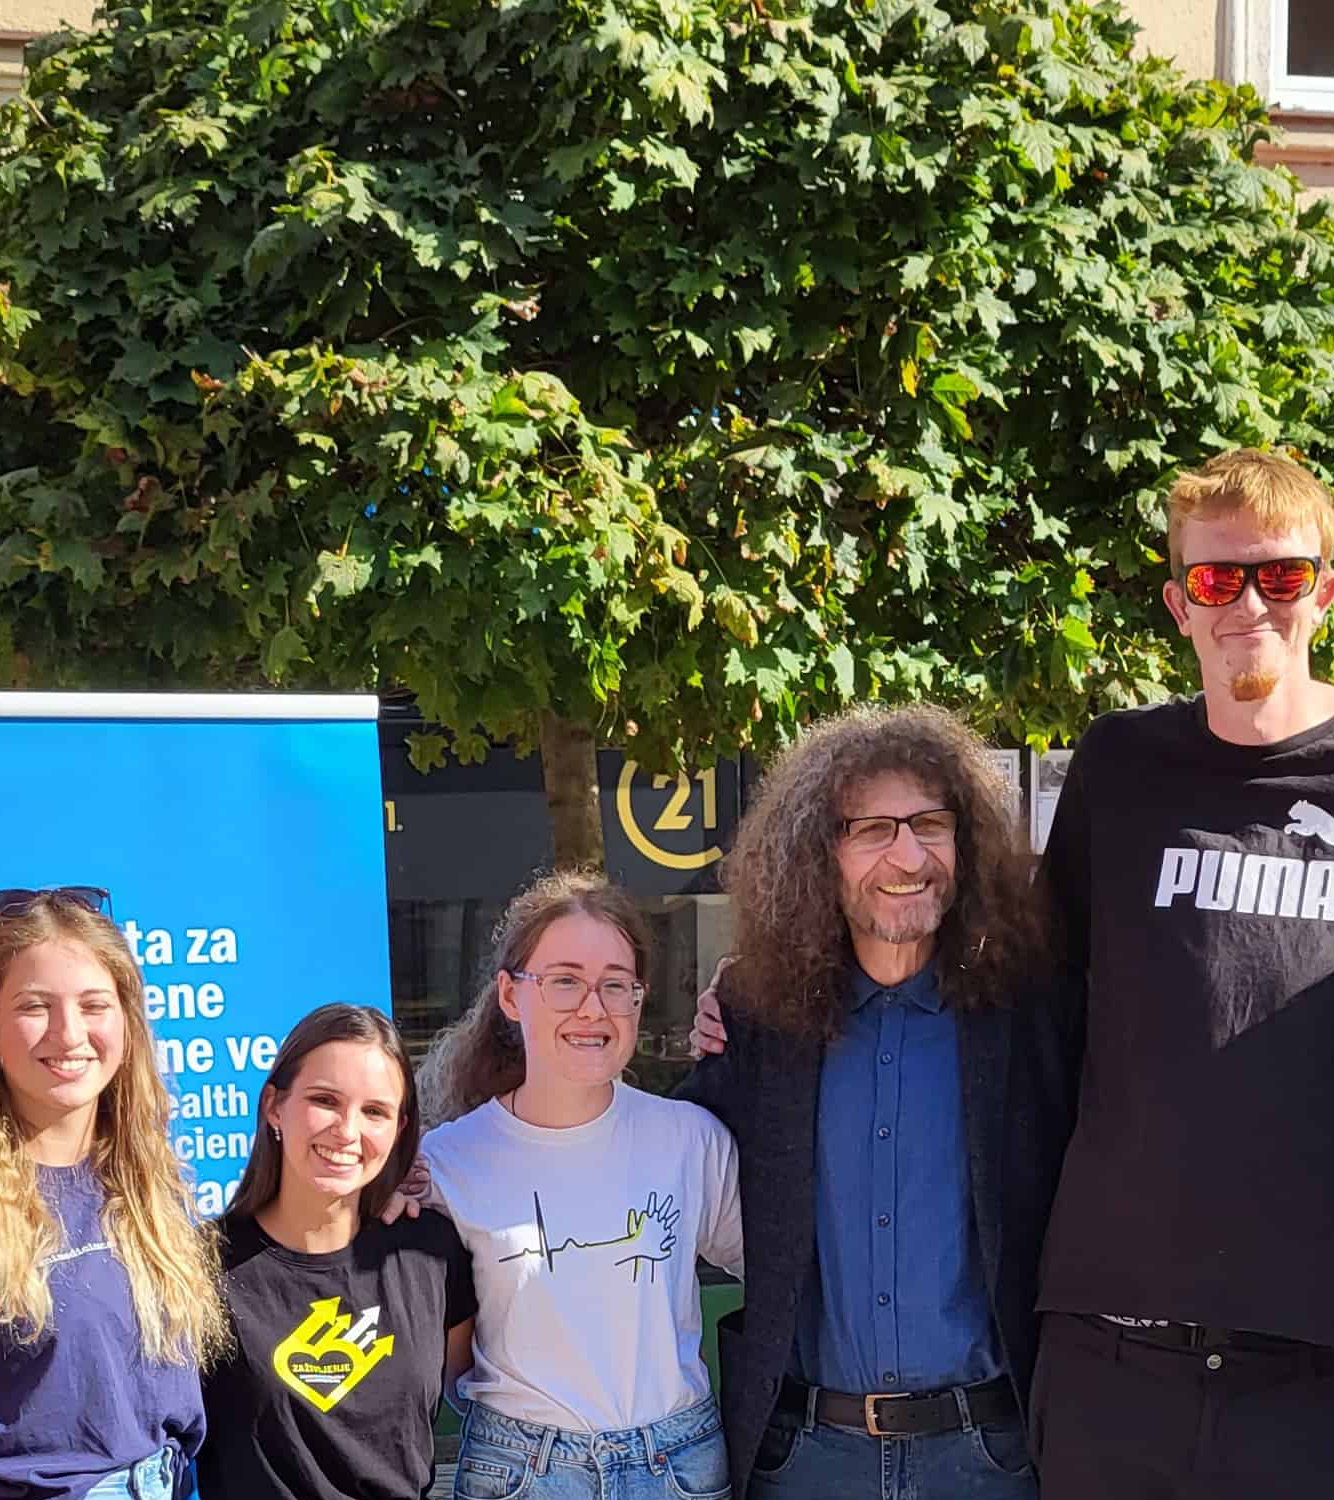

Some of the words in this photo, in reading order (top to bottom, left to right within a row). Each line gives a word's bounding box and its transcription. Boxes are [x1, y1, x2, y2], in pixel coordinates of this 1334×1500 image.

[186, 927, 238, 964] za
[144, 982, 225, 1020] ene
[225, 1034, 285, 1071] ve
[168, 1084, 248, 1119] ealth
[174, 1126, 256, 1160] cien
